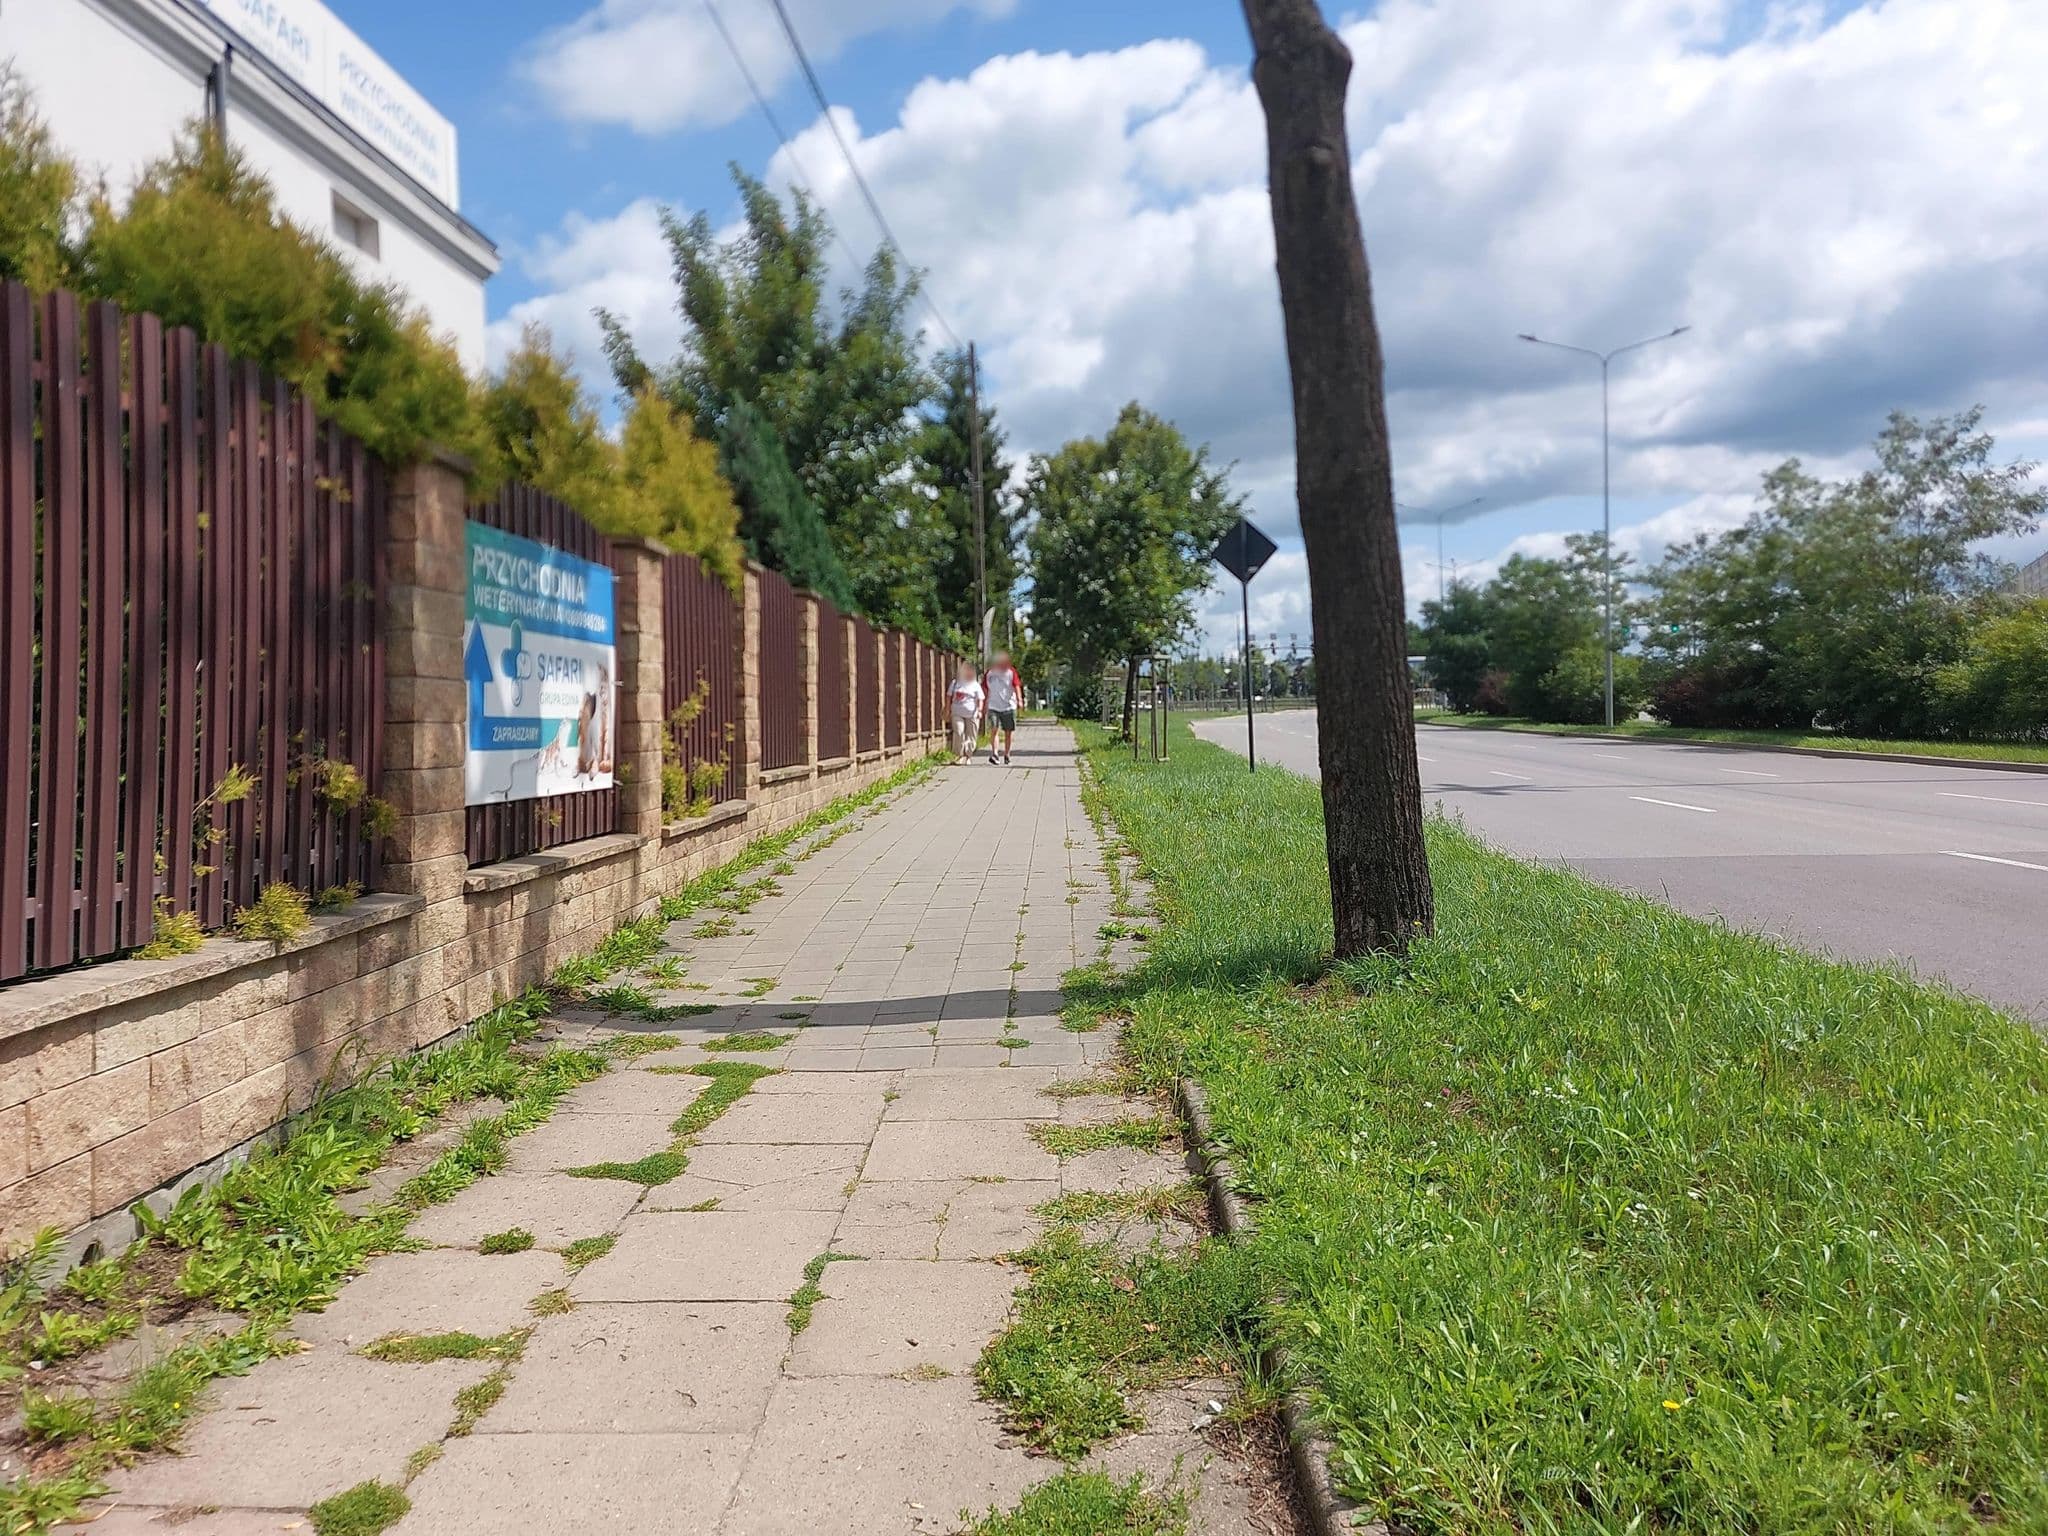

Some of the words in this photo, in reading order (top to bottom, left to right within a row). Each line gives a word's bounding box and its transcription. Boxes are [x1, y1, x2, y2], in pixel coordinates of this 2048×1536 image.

[472, 544, 585, 604] PRZYCHODNIA
[537, 653, 582, 684] SAFARI
[491, 726, 538, 742] ZAPRASZAMY
